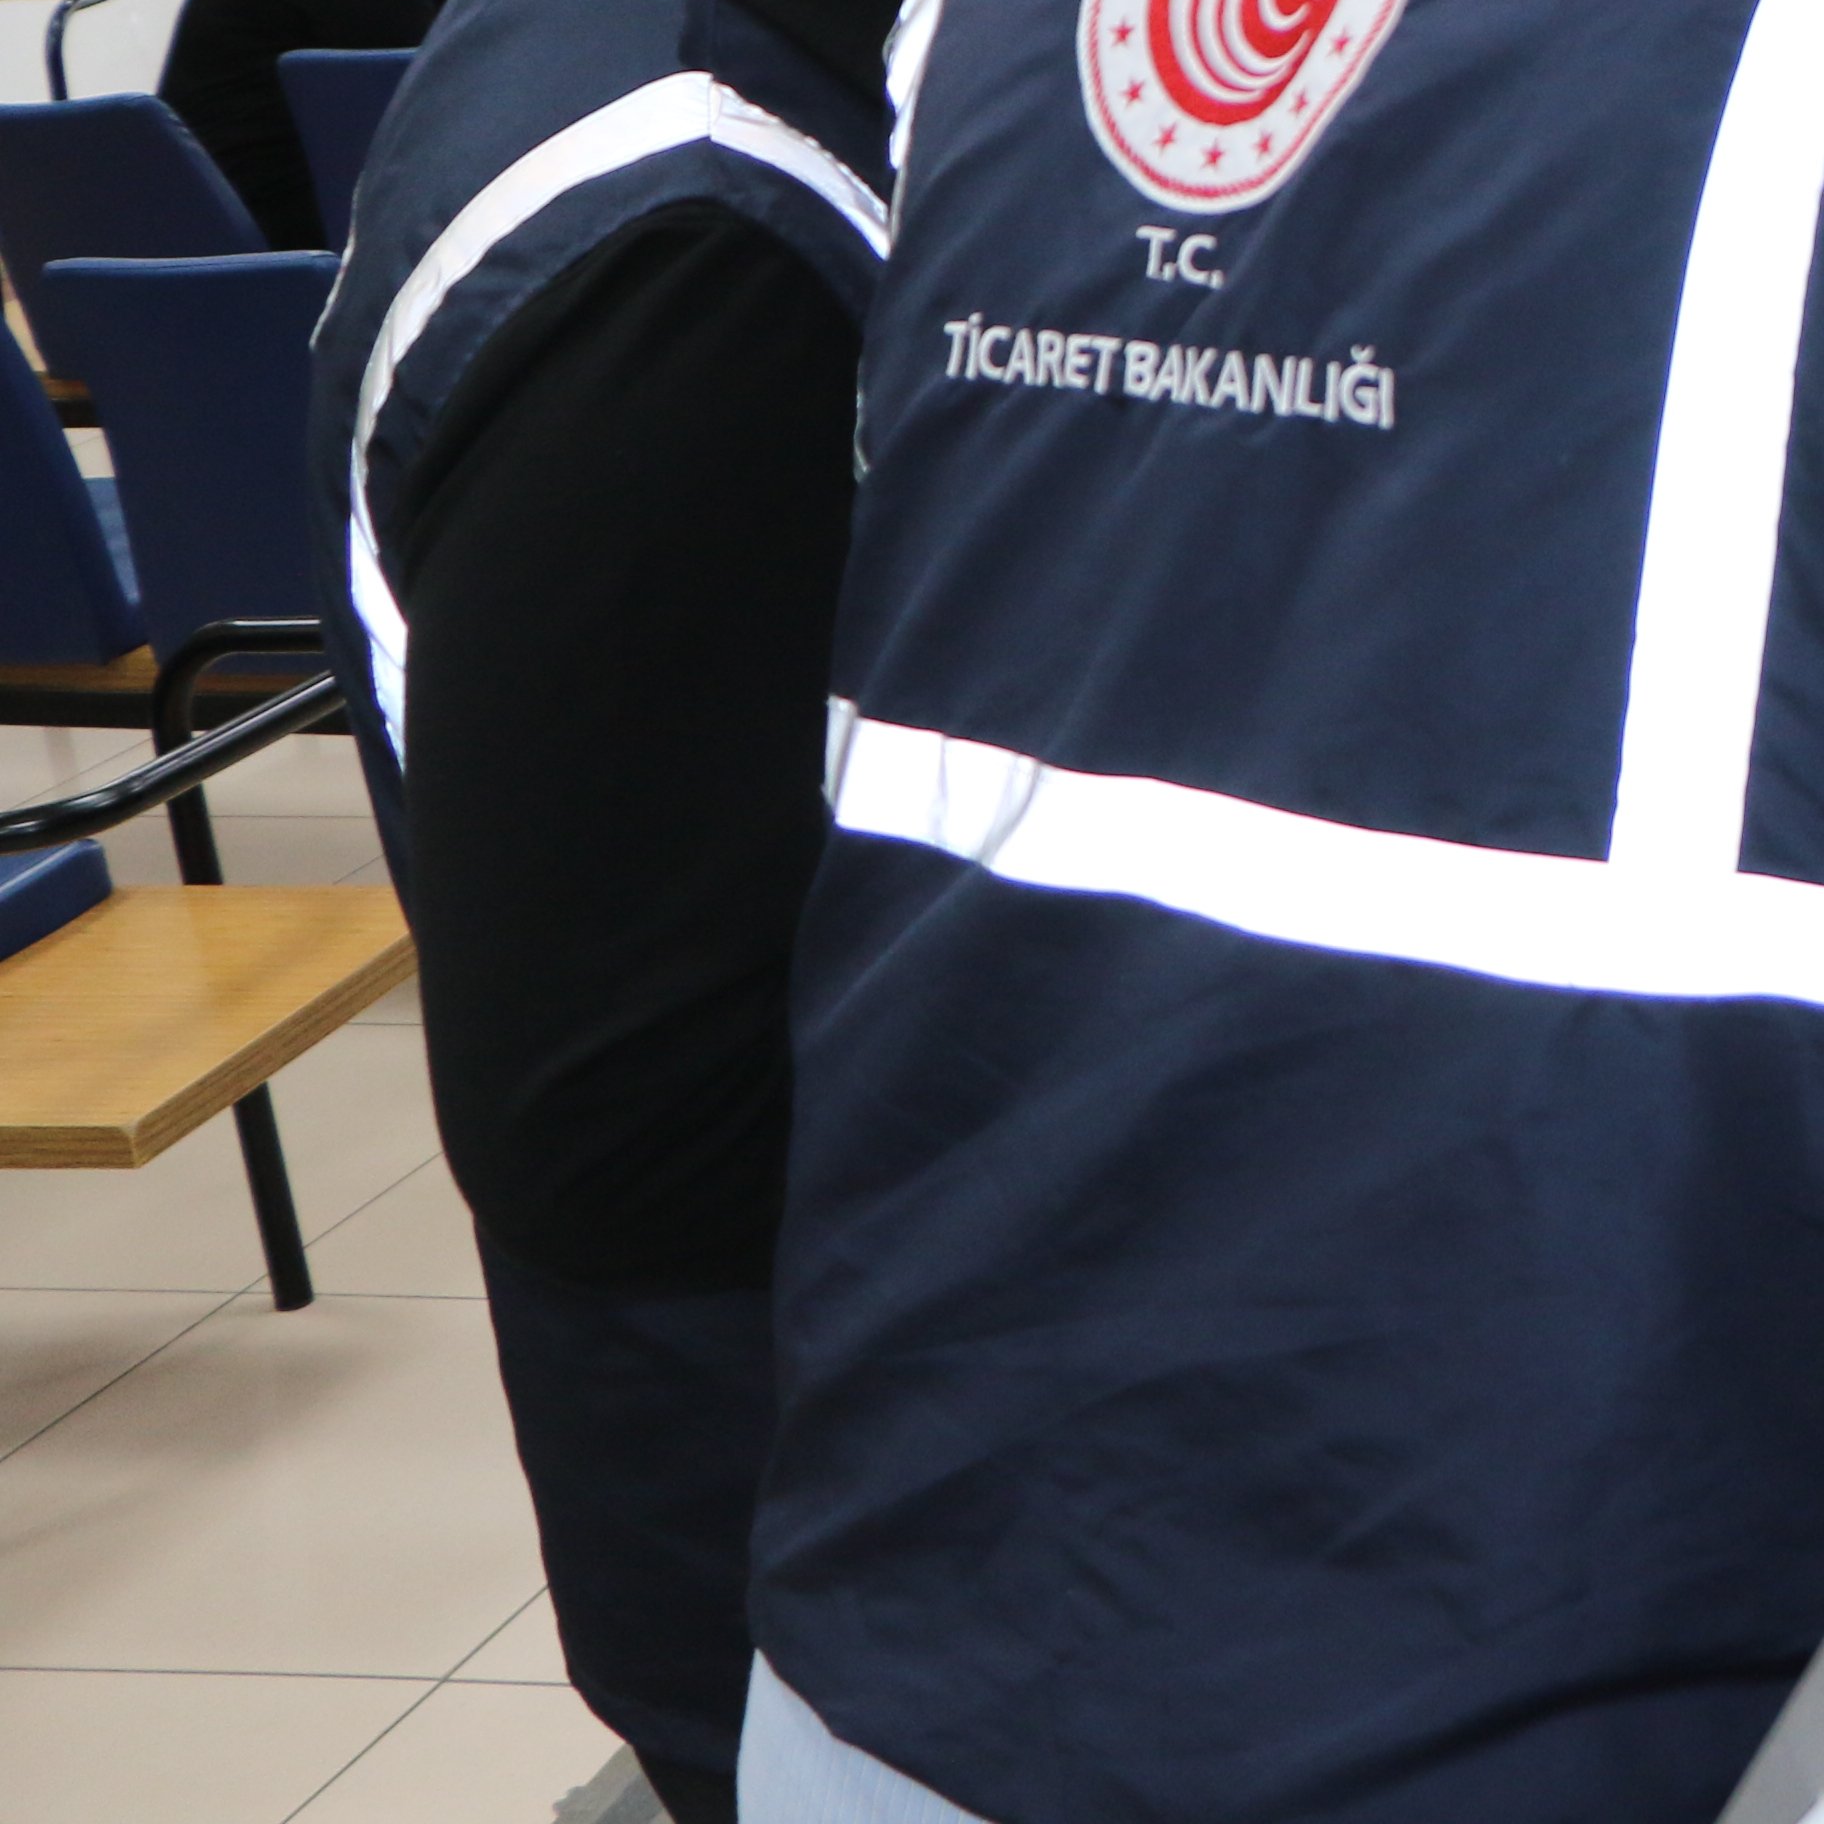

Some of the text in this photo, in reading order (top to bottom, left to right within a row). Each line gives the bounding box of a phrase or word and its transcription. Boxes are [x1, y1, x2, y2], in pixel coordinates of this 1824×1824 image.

[1135, 225, 1224, 289] T.C.
[943, 312, 1395, 430] TİCARET BAKANLIĞI
